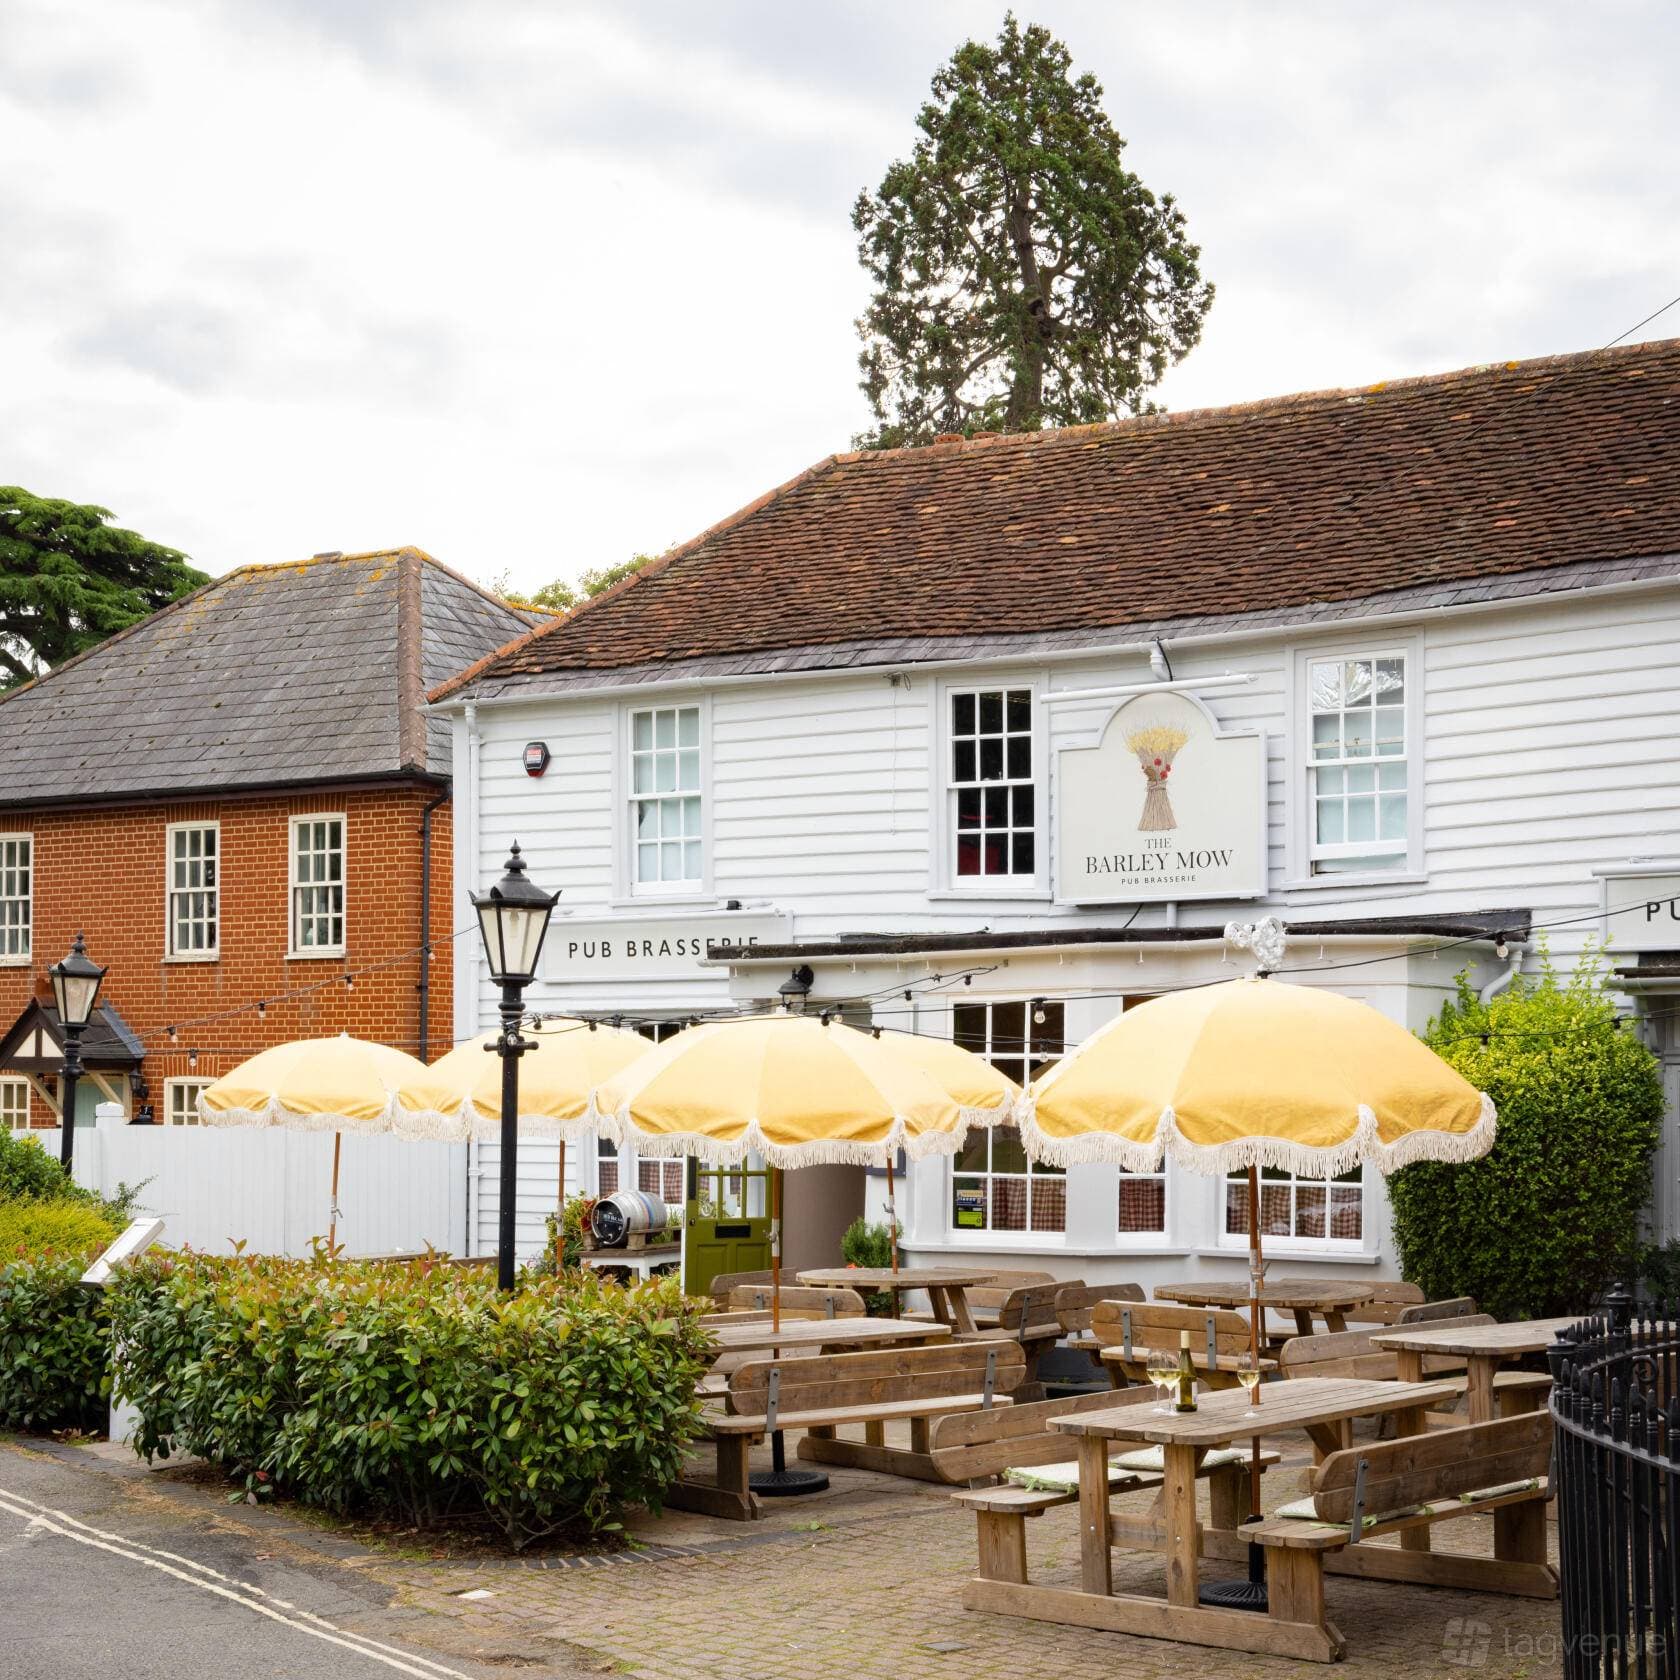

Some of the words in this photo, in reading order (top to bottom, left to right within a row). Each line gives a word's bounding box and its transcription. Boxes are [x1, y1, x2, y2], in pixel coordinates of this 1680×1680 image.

[1144, 838, 1172, 849] THE
[1086, 852, 1169, 874] BARLEY
[1176, 849, 1233, 869] MOW
[1121, 877, 1140, 885] PUB
[1144, 874, 1197, 884] BRASSERIE
[569, 941, 612, 959] PUB
